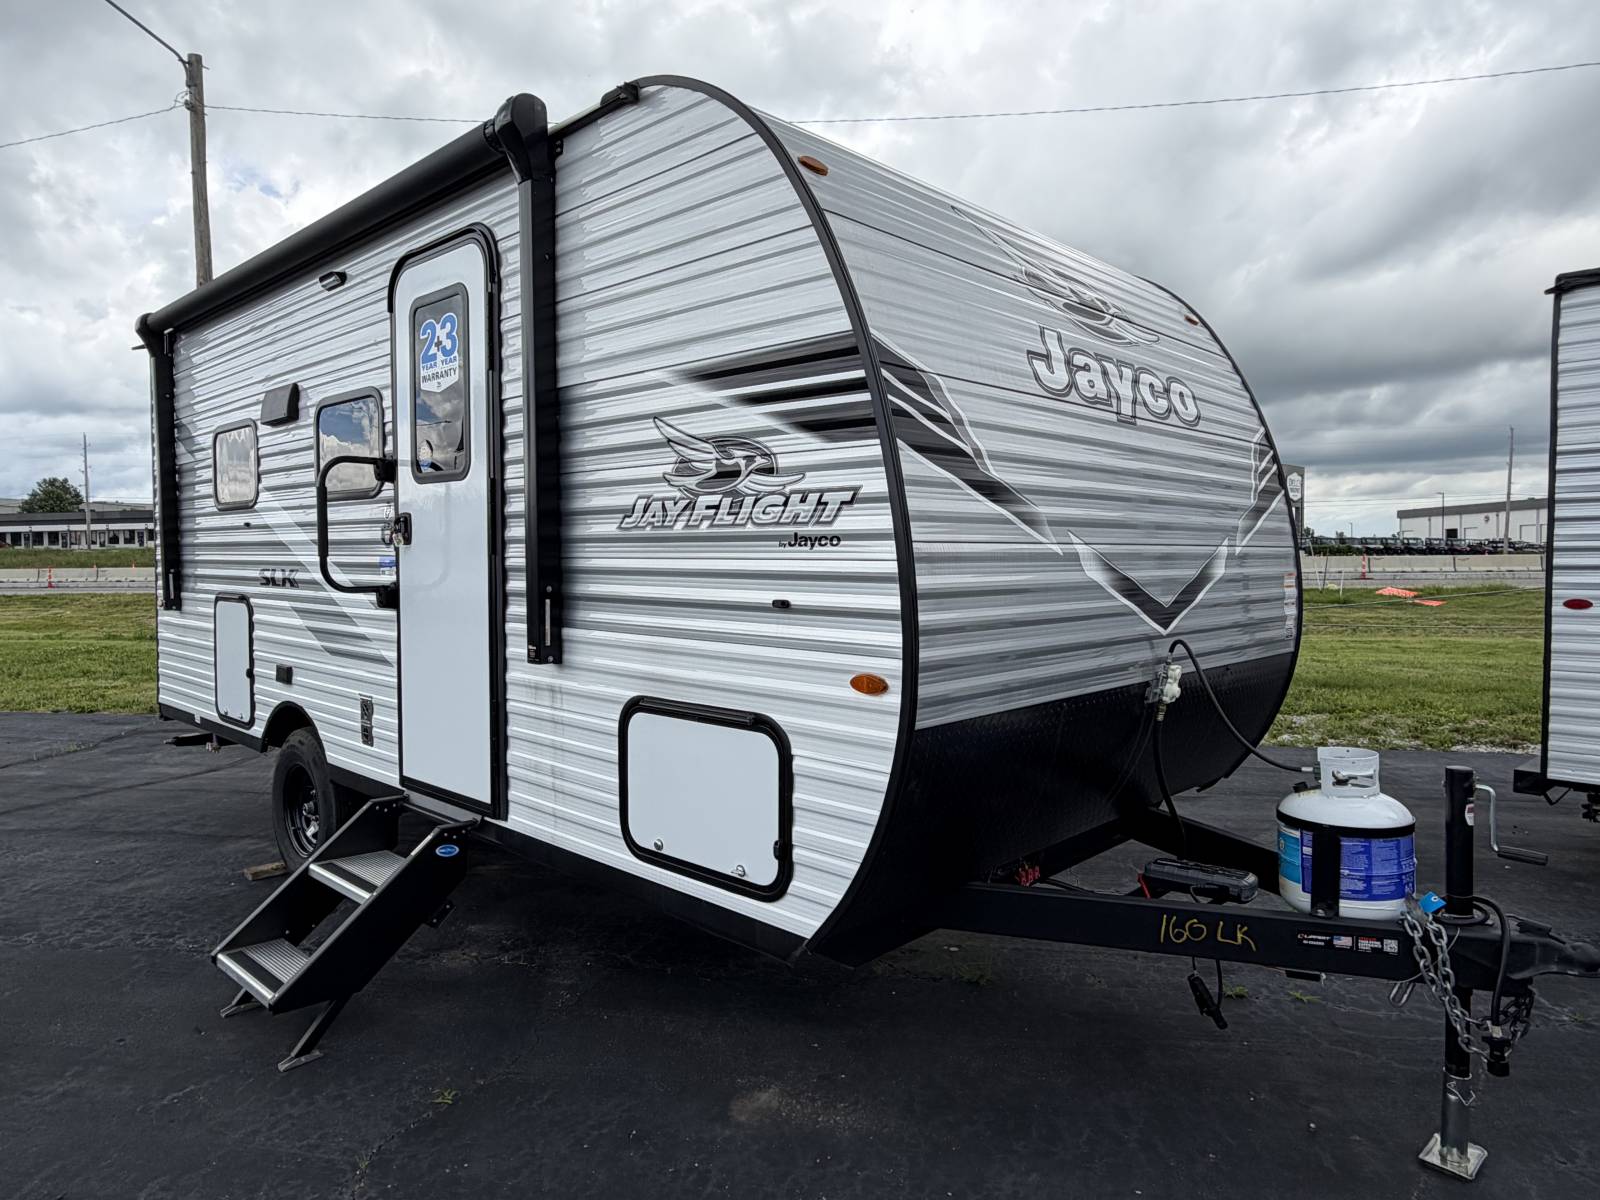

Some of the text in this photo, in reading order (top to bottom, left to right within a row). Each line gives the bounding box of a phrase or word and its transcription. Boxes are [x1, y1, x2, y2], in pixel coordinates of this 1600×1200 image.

[422, 356, 457, 371] YEAR YEAR
[421, 367, 458, 383] WARRANTY
[1027, 325, 1201, 427] Jayco
[788, 531, 842, 550] Jayco
[258, 568, 300, 588] SLK
[1160, 914, 1257, 952] 160 LK
